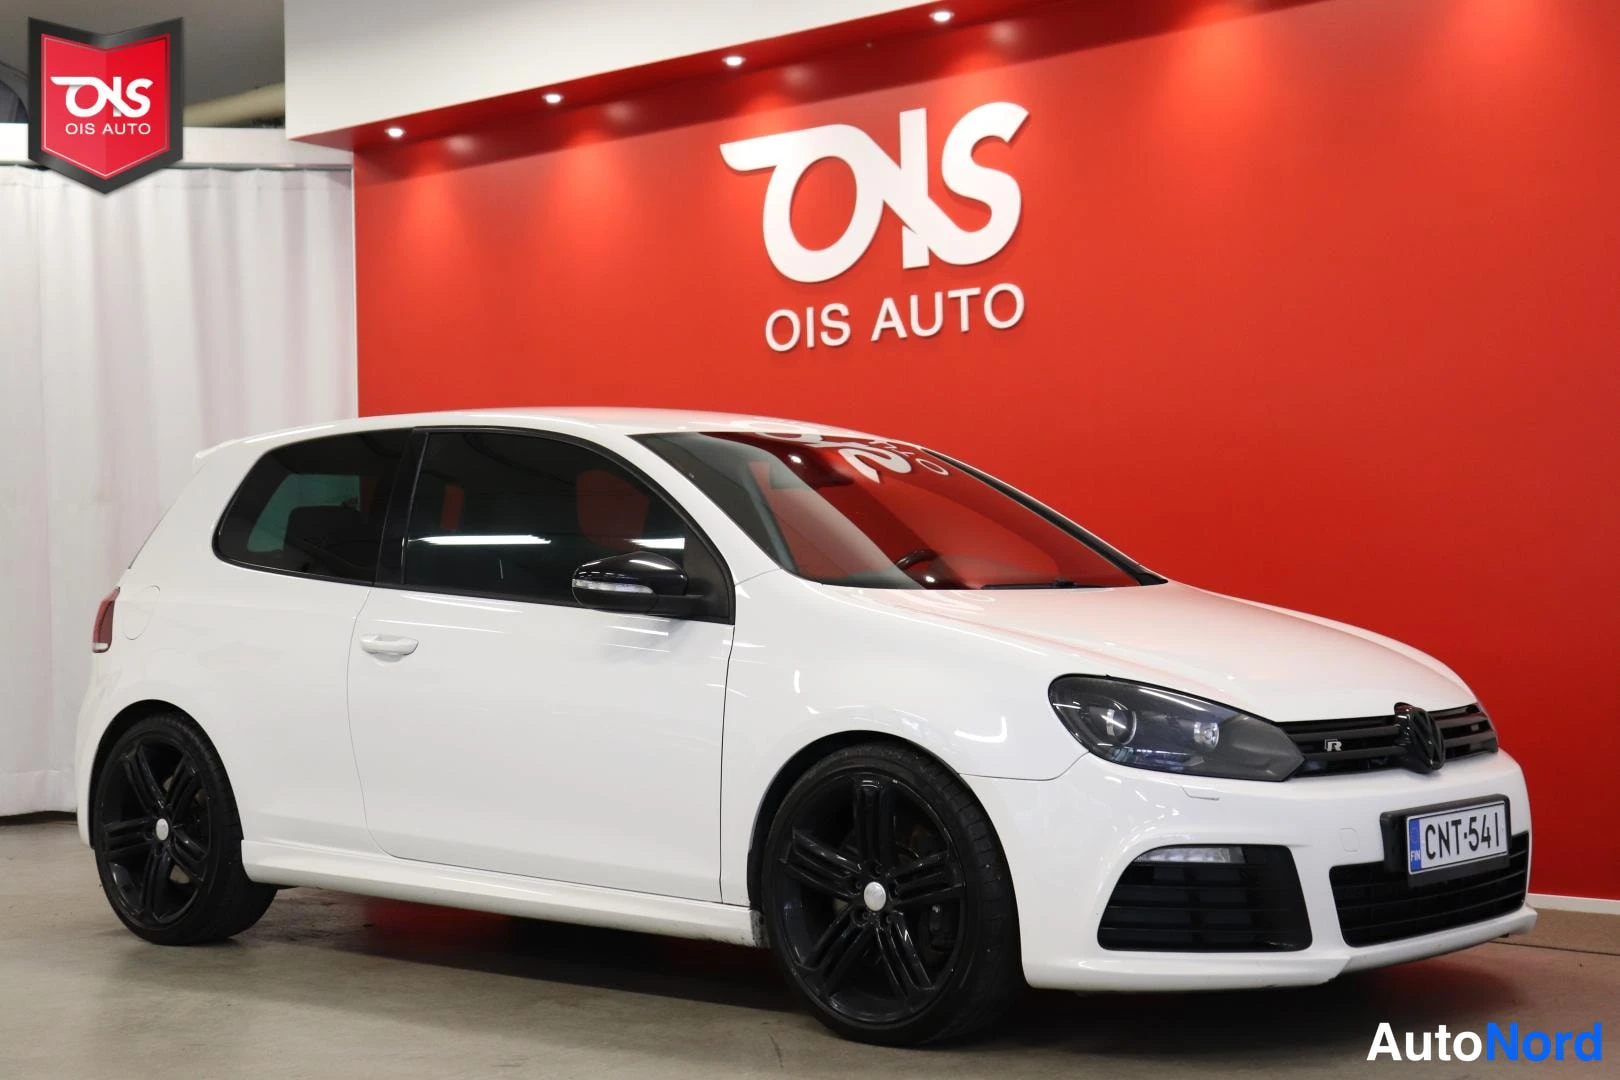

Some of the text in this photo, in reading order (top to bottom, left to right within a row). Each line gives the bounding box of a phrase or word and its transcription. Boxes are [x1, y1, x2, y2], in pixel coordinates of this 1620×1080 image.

[765, 283, 1025, 351] OIS AUTO
[1325, 738, 1342, 752] R
[1425, 812, 1499, 860] CNT-541
